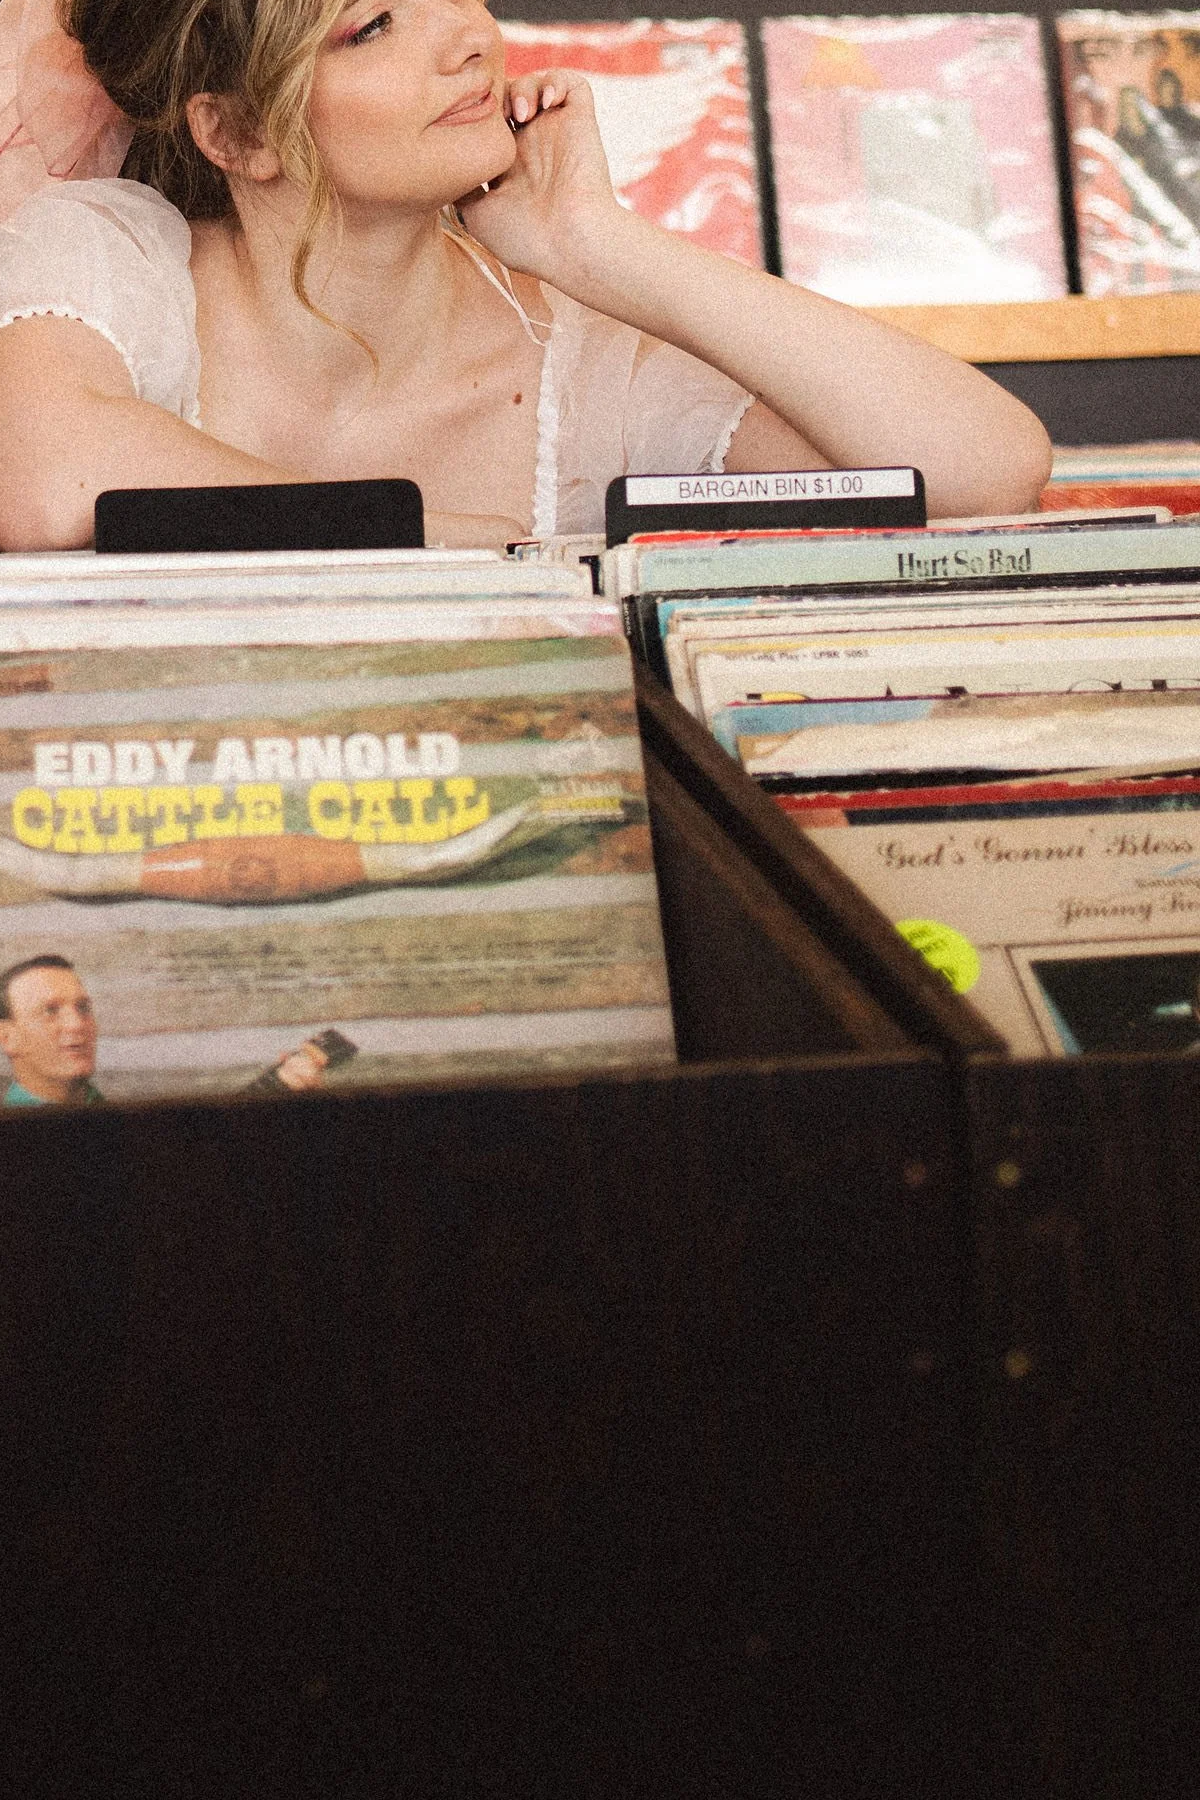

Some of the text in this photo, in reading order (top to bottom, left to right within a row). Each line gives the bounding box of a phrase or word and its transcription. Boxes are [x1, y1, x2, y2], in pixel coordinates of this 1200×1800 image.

[678, 475, 863, 499] BARGAIN BIN $1.00
[898, 547, 1032, 579] Hurt So Bad
[33, 731, 461, 786] EDDY ARNOLD
[12, 781, 287, 854] CATTLE
[308, 776, 491, 844] CALL
[877, 832, 1193, 869] God's Gonna Bless
